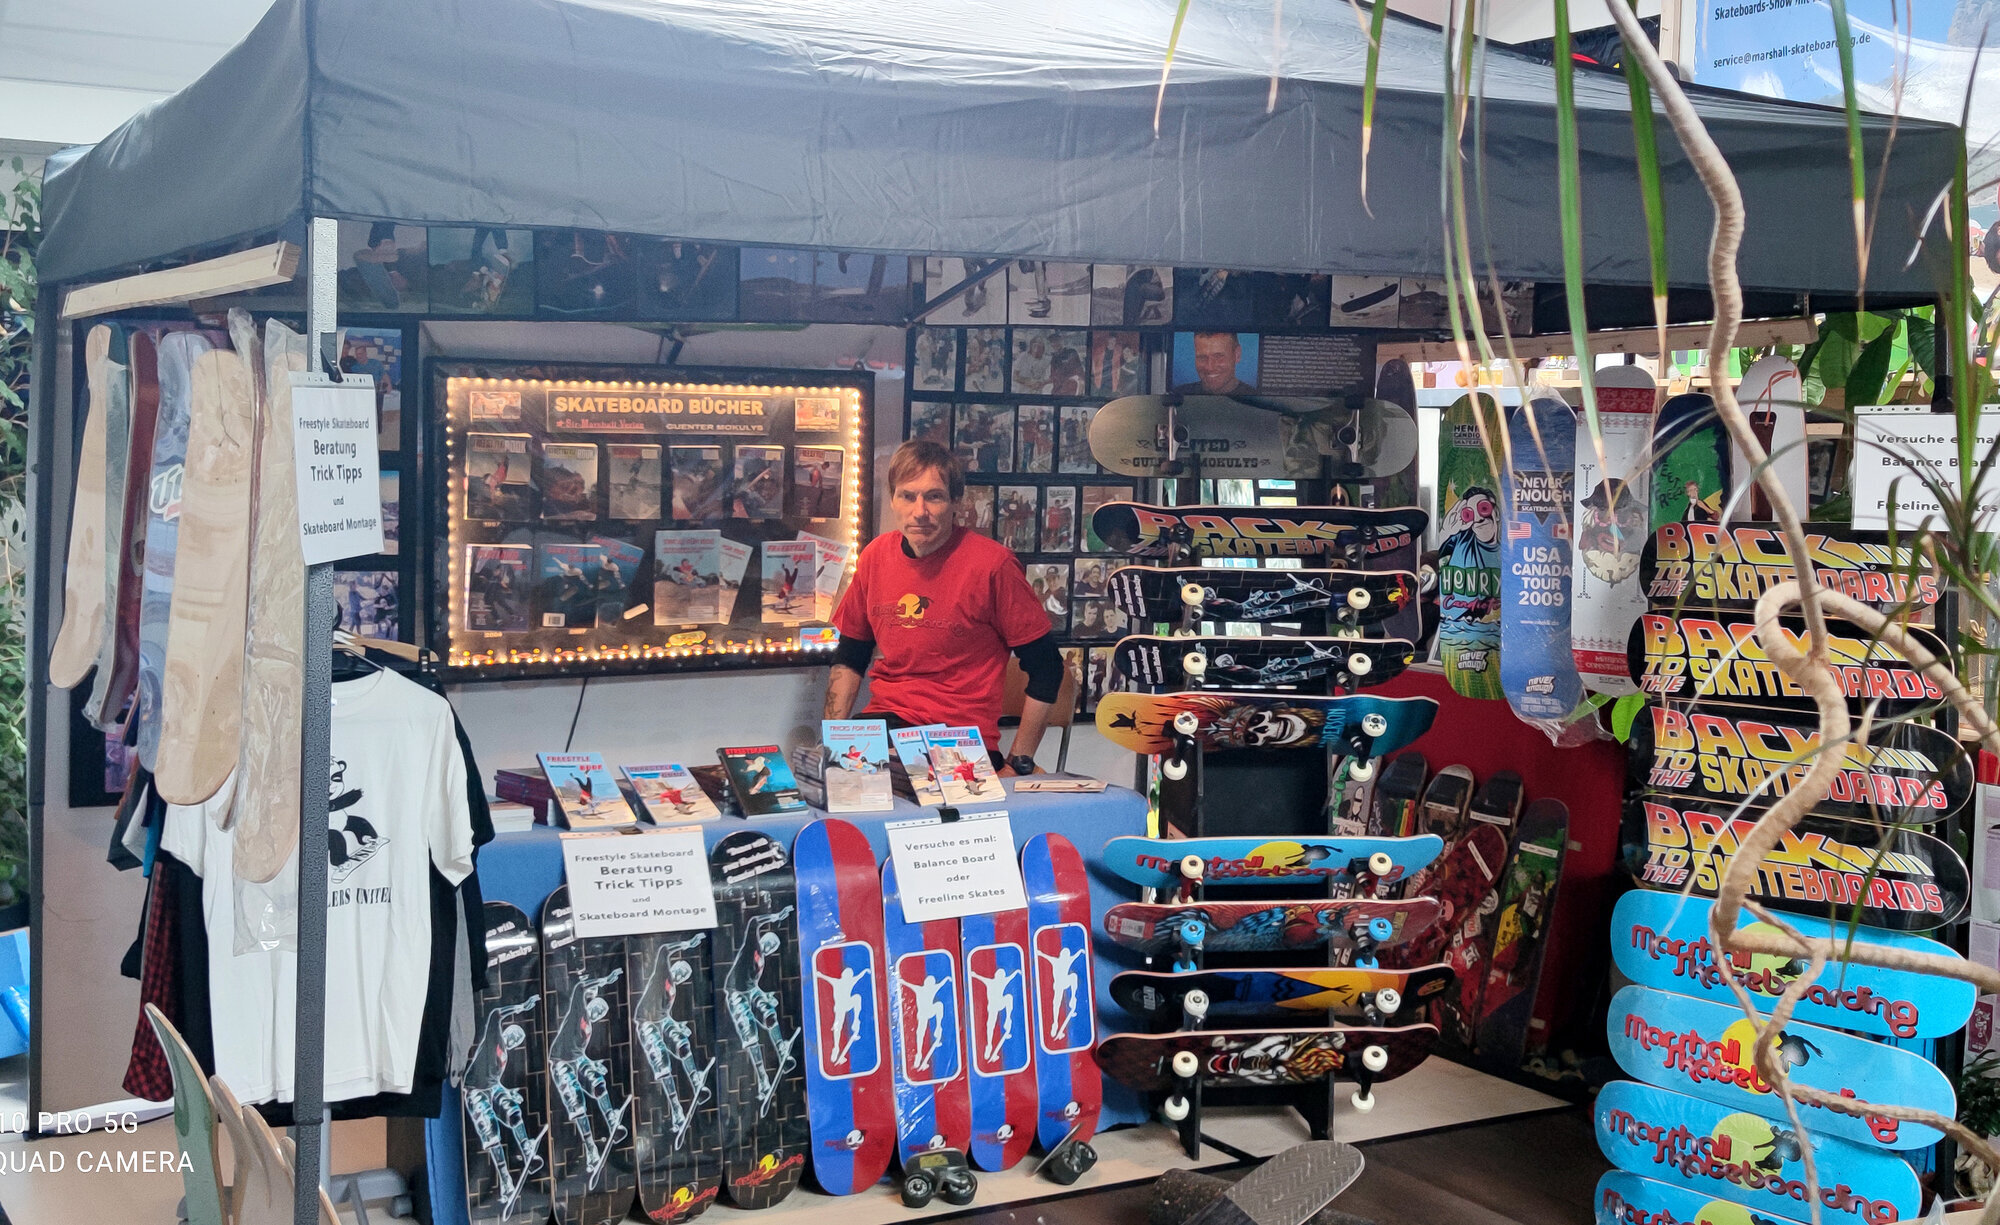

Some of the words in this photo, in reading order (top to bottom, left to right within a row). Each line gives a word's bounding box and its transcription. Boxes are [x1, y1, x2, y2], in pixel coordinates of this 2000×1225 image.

[1713, 33, 1871, 68] service@marshall-skateboarg.de
[555, 397, 683, 414] SKATEBOARD
[688, 397, 764, 416] BÜCHER
[299, 417, 330, 432] Freestyle
[332, 418, 369, 429] Skateboard
[666, 423, 714, 431] GUENTER
[716, 424, 764, 432] MOKULYS
[1876, 434, 1945, 444] Versuche
[313, 439, 357, 459] Beratung
[1882, 457, 1943, 467] Balance
[310, 464, 335, 482] Trick
[336, 464, 363, 484] Tipps
[332, 496, 345, 506] und
[1877, 500, 1940, 511] Feeline
[303, 519, 345, 536] Skateboard
[346, 518, 377, 530] Montage
[1523, 546, 1561, 563] USA
[1655, 521, 1868, 570] BACK
[1511, 562, 1573, 578] CANADA
[1654, 561, 1688, 579] TO
[1521, 576, 1561, 590] TOUR
[1648, 580, 1688, 598] THE
[1694, 561, 1940, 605] SKATEOARDS
[1518, 590, 1565, 607] 2009
[1643, 656, 1687, 676] TO
[1639, 674, 1687, 693] THE
[1688, 656, 1947, 700] SKATEOARDS
[1650, 705, 1877, 772] BACK
[1653, 750, 1696, 771] TO
[1647, 768, 1696, 788] THE
[1697, 753, 1948, 810] SKATEOARDS
[905, 840, 956, 852] Versuche
[958, 838, 970, 846] es
[973, 834, 998, 845] mal:
[575, 853, 627, 866] Freestyle
[629, 849, 694, 860] Skateboard
[913, 858, 959, 870] Balance
[961, 853, 997, 864] Board
[1647, 845, 1689, 867] TO
[600, 864, 674, 876] Beratung
[946, 873, 971, 883] oder
[1641, 863, 1690, 885] THE
[594, 878, 635, 890] Trick
[639, 877, 684, 889] Tipps
[328, 887, 351, 907] ERS
[632, 895, 651, 903] und
[918, 892, 965, 905] Freeline
[967, 887, 1006, 899] Skates
[579, 910, 649, 921] Skateboard
[653, 906, 707, 918] Montage
